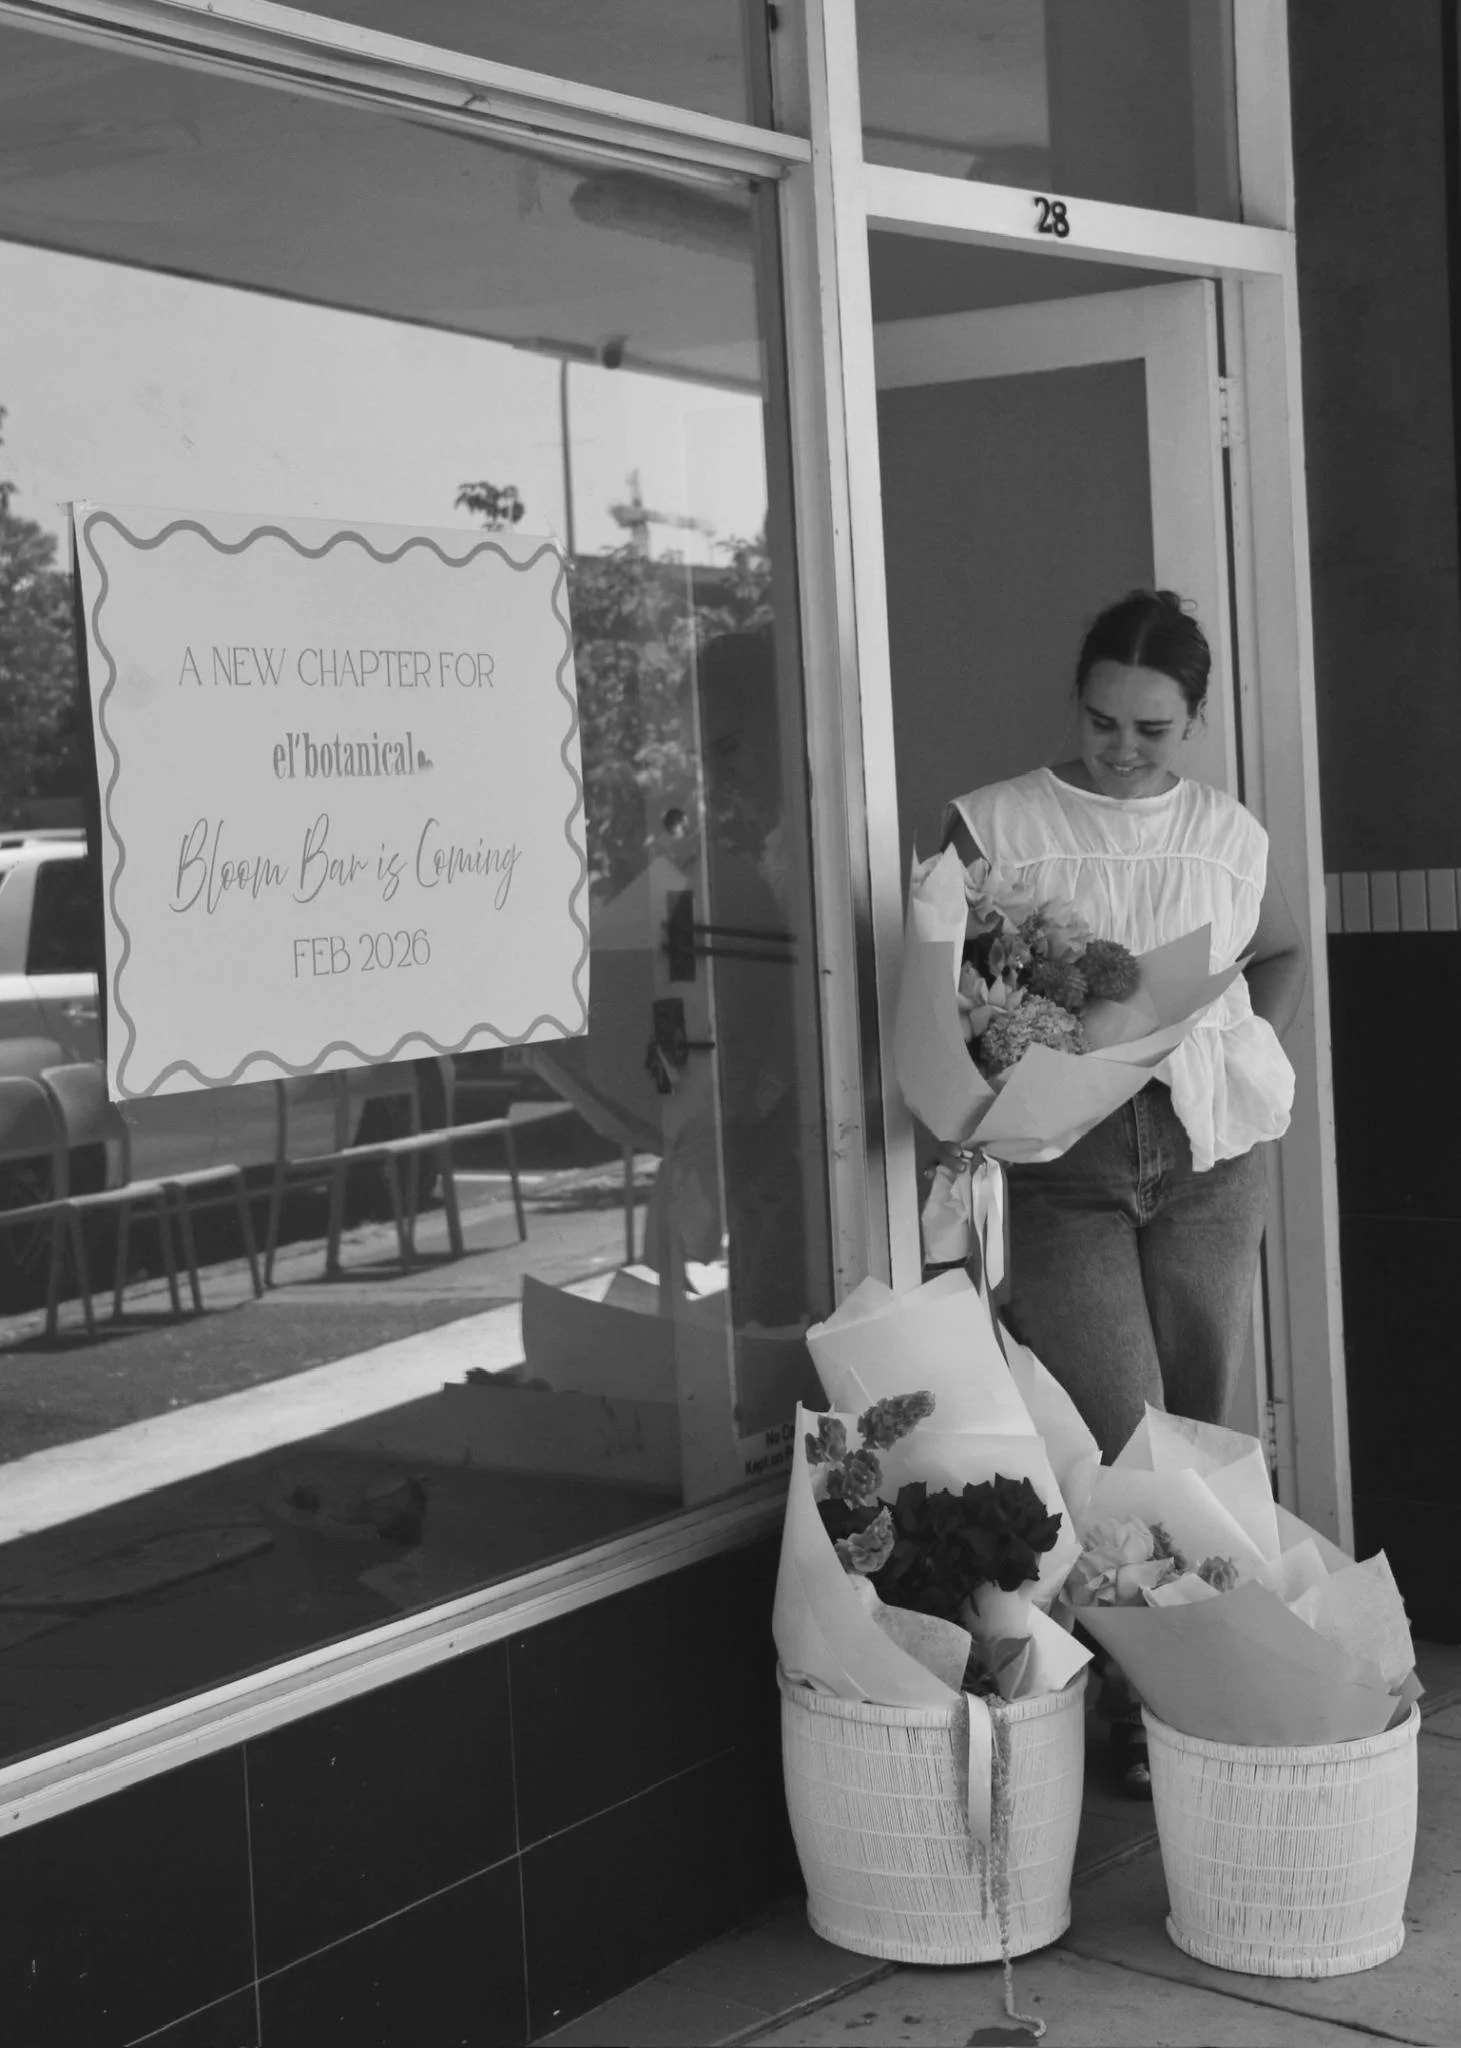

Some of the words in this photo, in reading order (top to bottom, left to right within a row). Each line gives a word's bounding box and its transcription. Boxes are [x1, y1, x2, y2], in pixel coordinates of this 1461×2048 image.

[1033, 196, 1070, 239] 28
[178, 646, 202, 686] A
[212, 646, 286, 686] NEW
[297, 648, 431, 688] CHAPTER
[439, 651, 495, 688] FOR
[169, 817, 289, 914] Bloom
[292, 813, 368, 903] Bar
[377, 843, 408, 902] is
[416, 817, 522, 911] Coming
[293, 936, 351, 978] FEB
[359, 928, 431, 971] 2026
